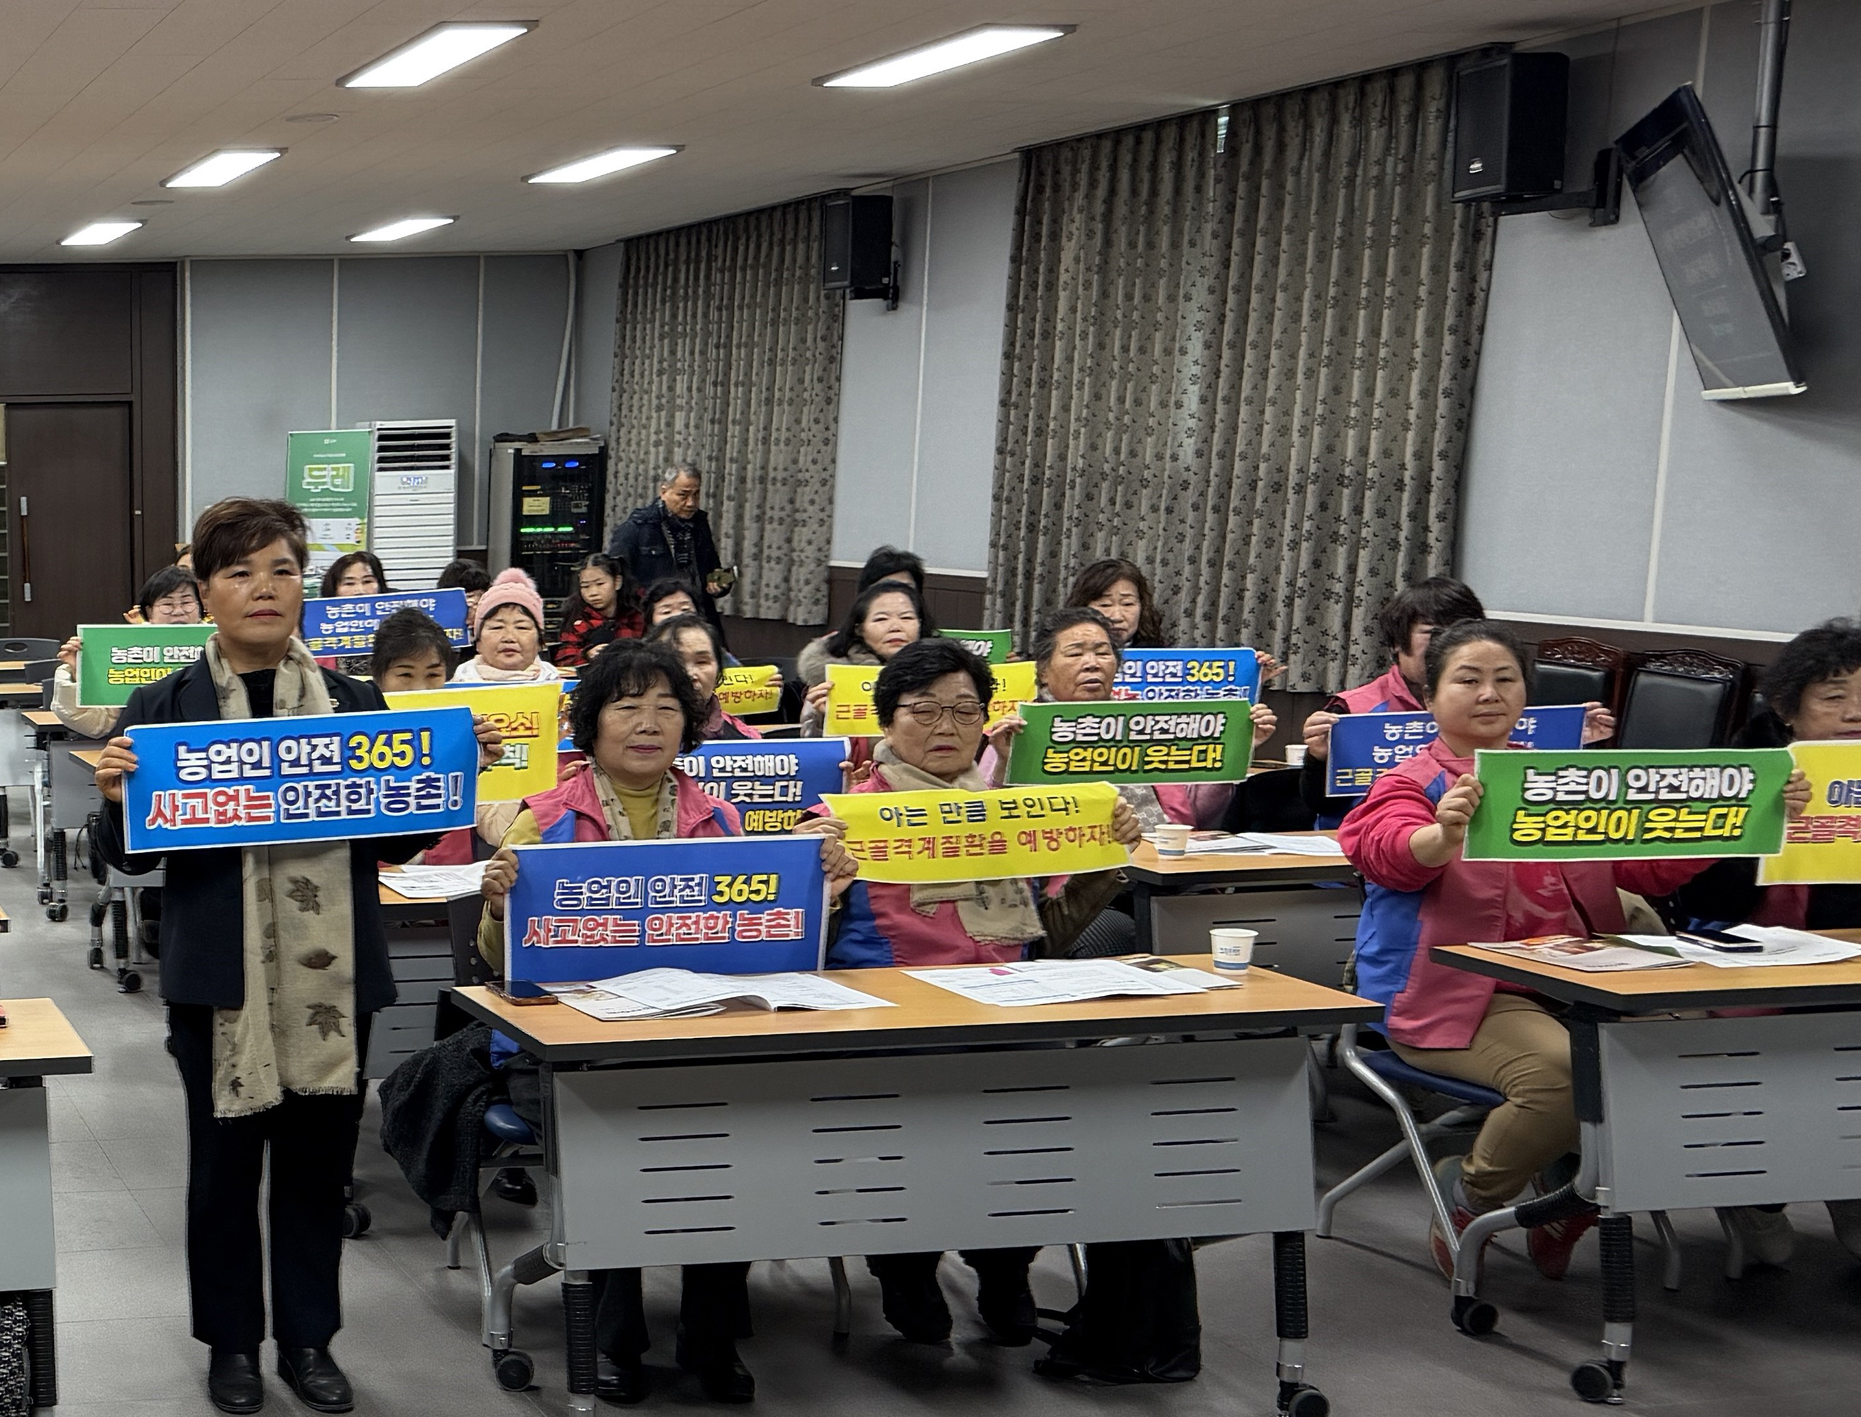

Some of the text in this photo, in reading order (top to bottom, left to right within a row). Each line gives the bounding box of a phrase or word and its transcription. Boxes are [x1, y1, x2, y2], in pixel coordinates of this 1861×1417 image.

[111, 646, 160, 664] 농촌이
[1146, 660, 1183, 682] 안전
[718, 689, 773, 703] 예방하자!
[1050, 713, 1226, 742] 농촌이 안전해야
[177, 740, 271, 781] 농업인
[278, 736, 342, 775] 안전
[710, 754, 799, 777] 안전해야
[1043, 744, 1224, 773] 농업인이 웃는다!
[731, 781, 803, 803] 웃는다!
[1523, 766, 1756, 802] 농촌이 안전해야
[146, 785, 275, 829] 사고없는
[277, 779, 377, 822] 안전한
[879, 795, 1081, 828] 아는 만큼 보인다!
[1511, 807, 1750, 842] 농업인이 웃는다!
[846, 823, 1114, 862] 근골격계질환을 예방하자!
[554, 874, 779, 910] 농업인 안전 365!
[523, 908, 806, 948] 사고없는 안전한 농촌!
